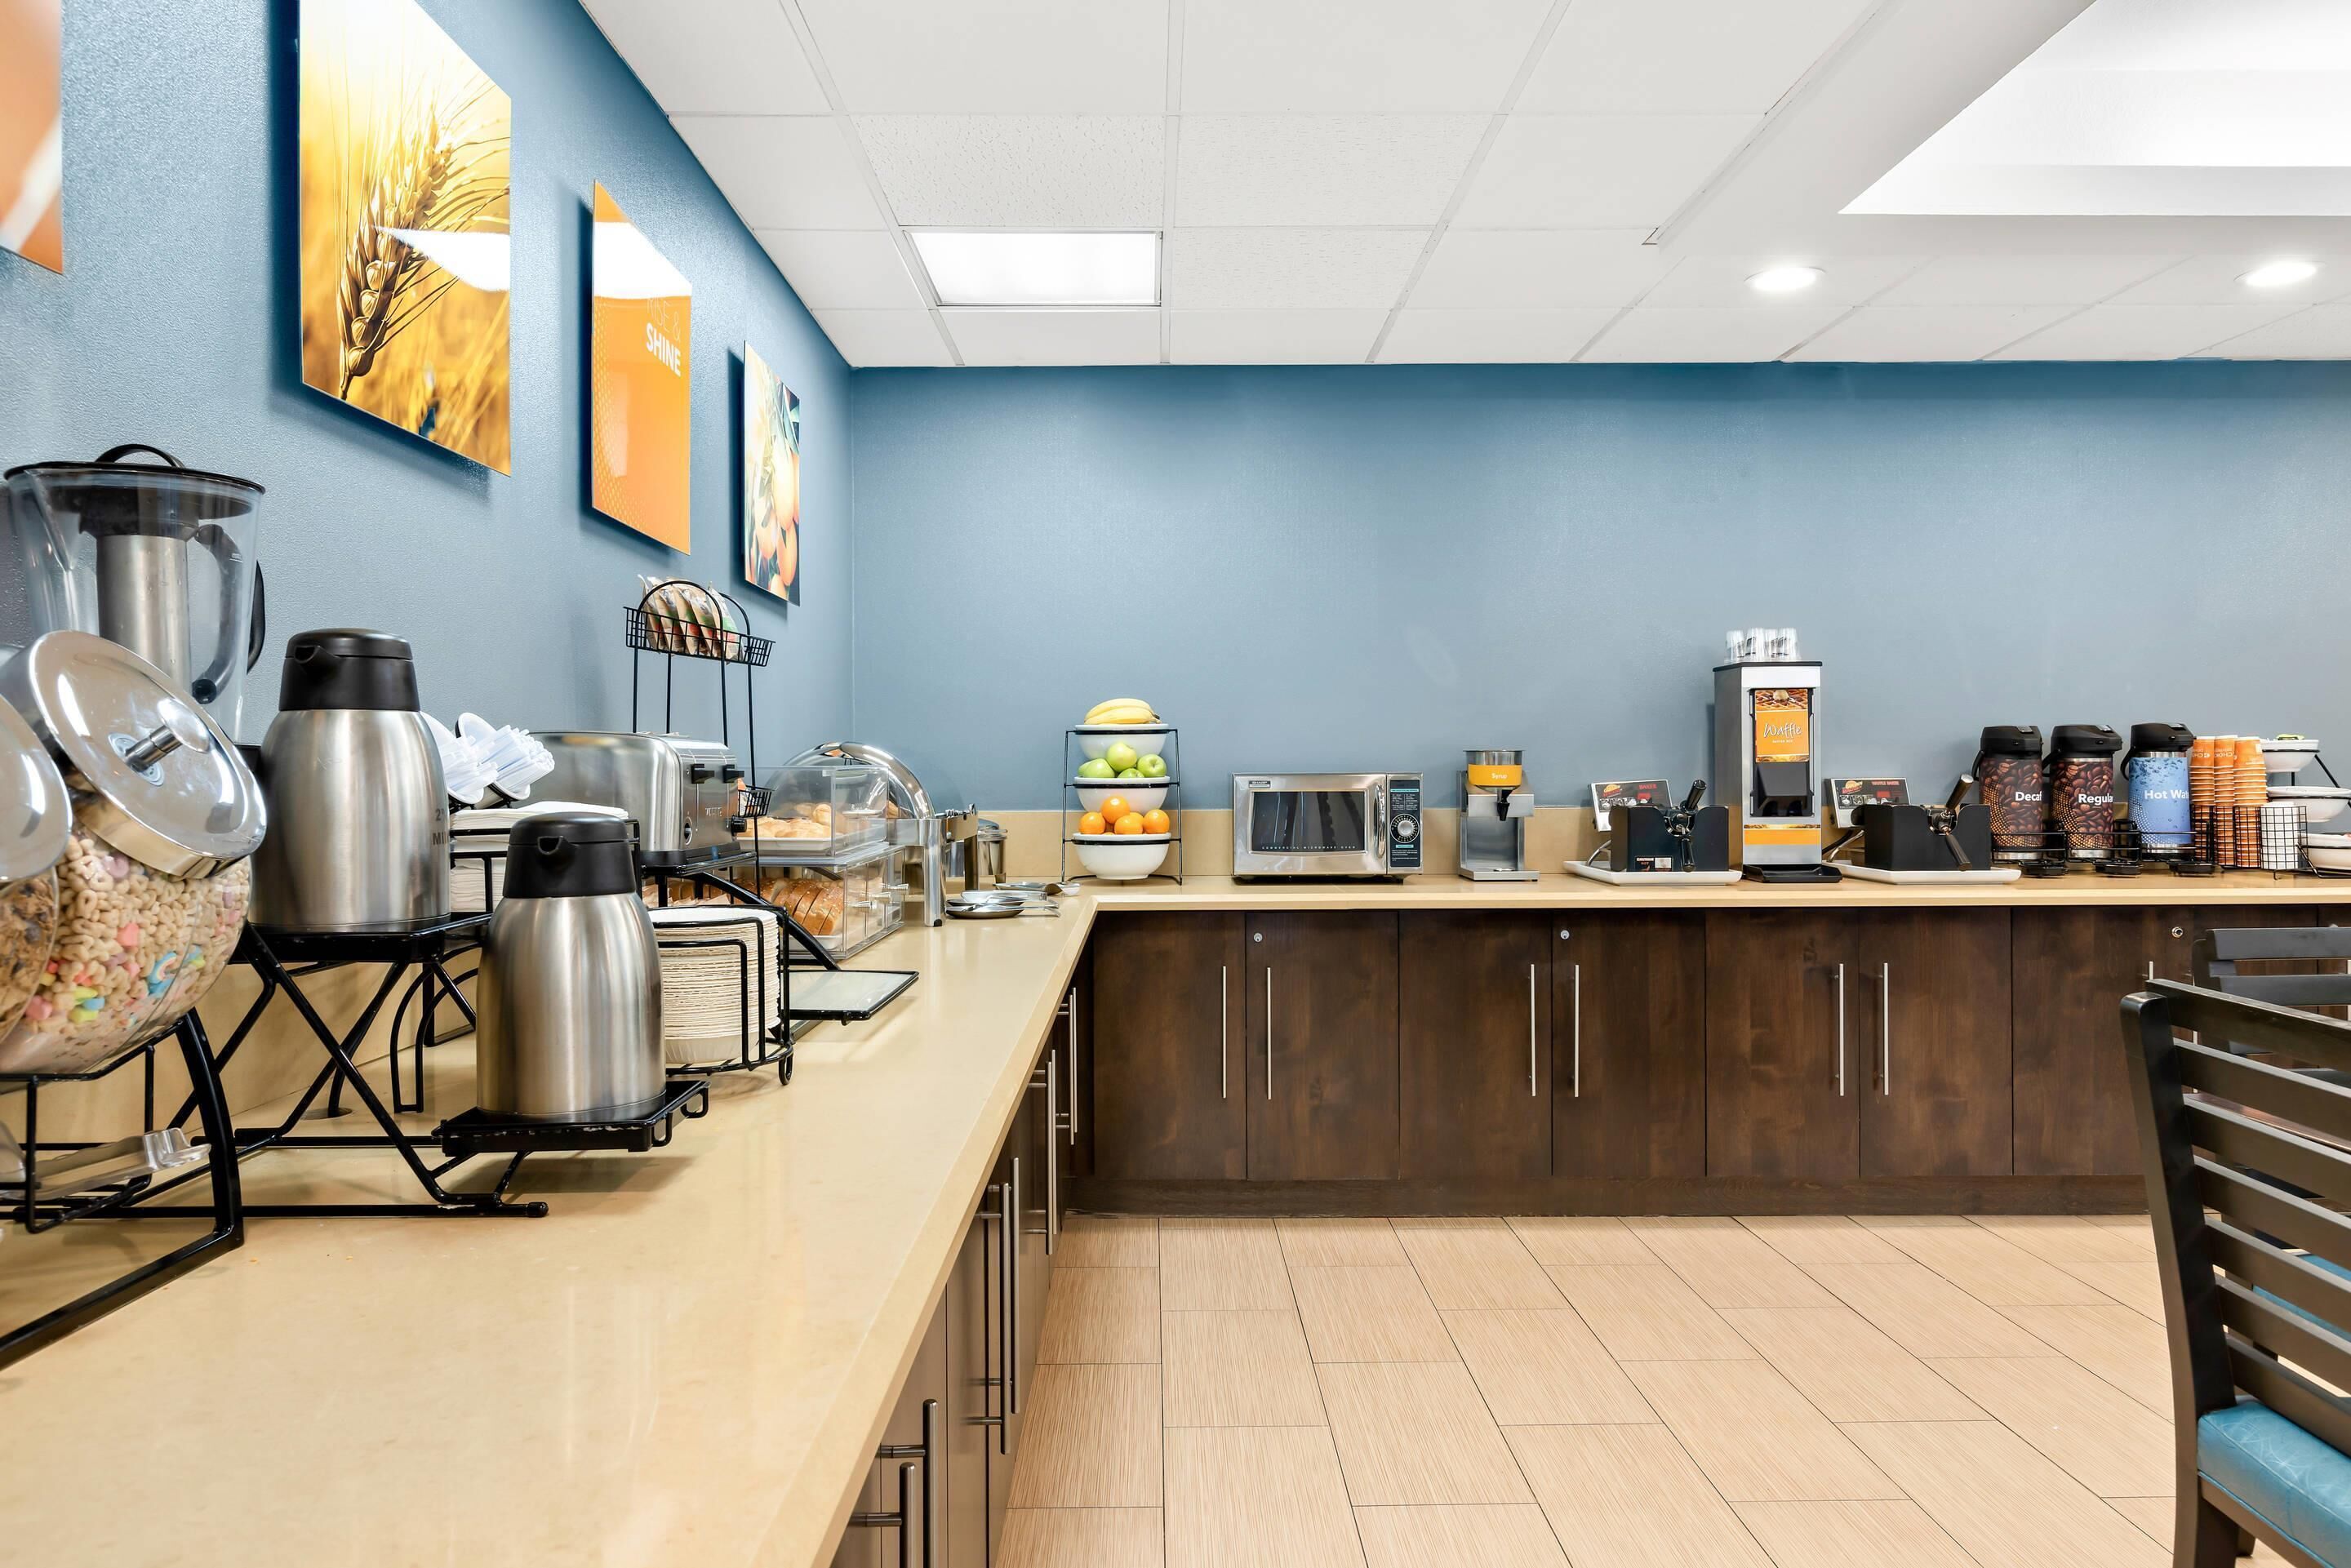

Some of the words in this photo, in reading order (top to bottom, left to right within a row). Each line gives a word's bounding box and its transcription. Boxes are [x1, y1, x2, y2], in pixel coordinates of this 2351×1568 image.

[647, 295, 670, 333] RISE
[647, 322, 681, 377] SHINE
[1763, 722, 1802, 739] Waffle
[2015, 791, 2042, 801] Decaf
[2078, 793, 2113, 806] Regula
[2144, 789, 2168, 799] Hot
